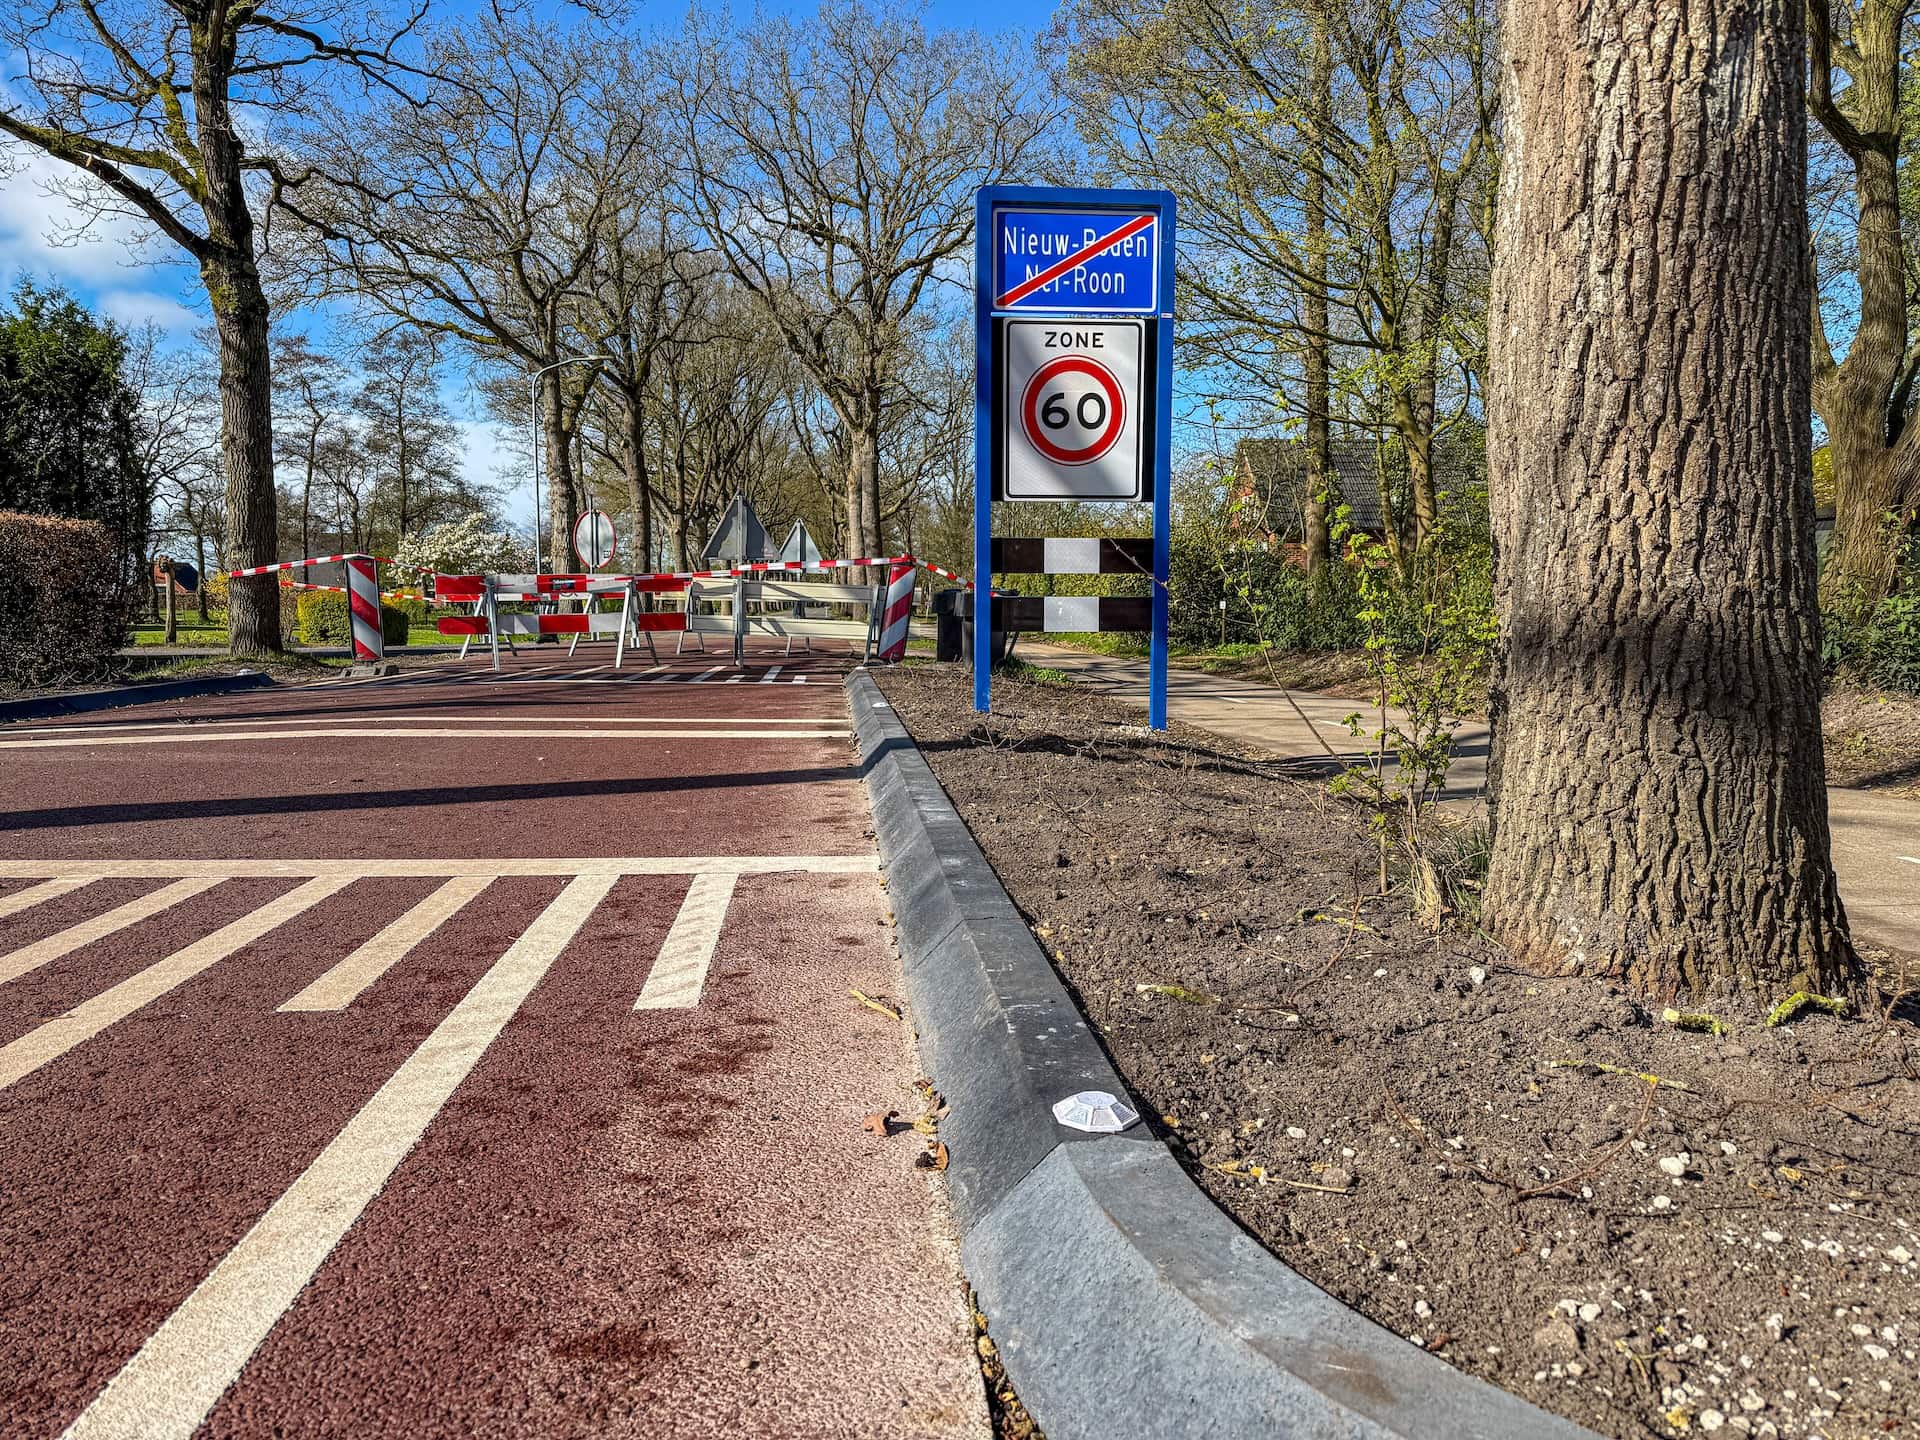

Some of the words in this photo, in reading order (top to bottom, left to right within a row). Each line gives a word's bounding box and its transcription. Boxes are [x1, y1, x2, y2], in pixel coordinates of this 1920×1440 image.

[1004, 226, 1147, 258] Nieuw-Ren
[1044, 331, 1104, 348] ZONE
[1041, 392, 1106, 429] 60
